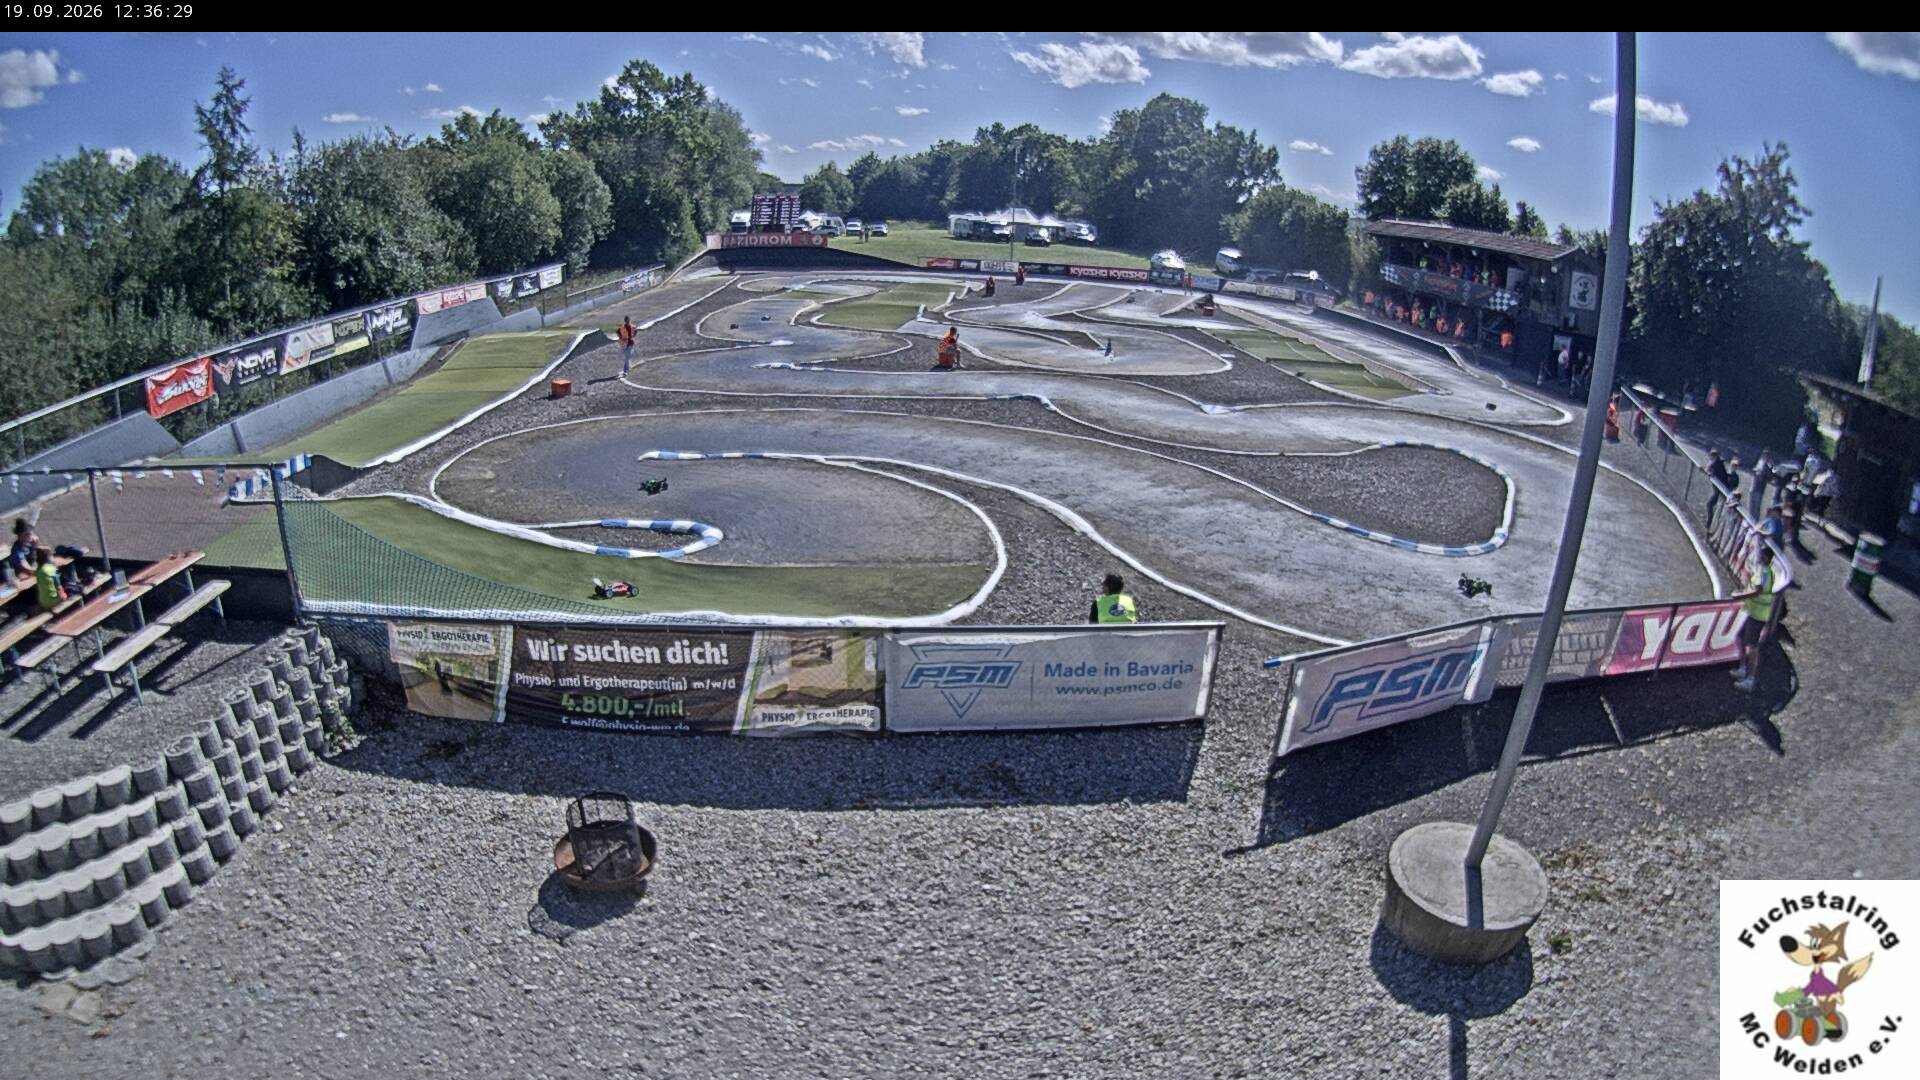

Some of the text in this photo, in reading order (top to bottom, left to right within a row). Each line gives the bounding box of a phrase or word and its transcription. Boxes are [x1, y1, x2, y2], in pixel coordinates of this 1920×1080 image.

[526, 638, 729, 665] Wir suchen dich!
[904, 661, 1020, 687] PSM
[1044, 659, 1194, 678] Made in Bavaria
[515, 672, 736, 692] Physio- und Ergotherapeut(in) m/w/d
[1056, 676, 1183, 696] www.psmco.de
[1309, 648, 1484, 726] PSM
[762, 713, 796, 722] PHYSIO
